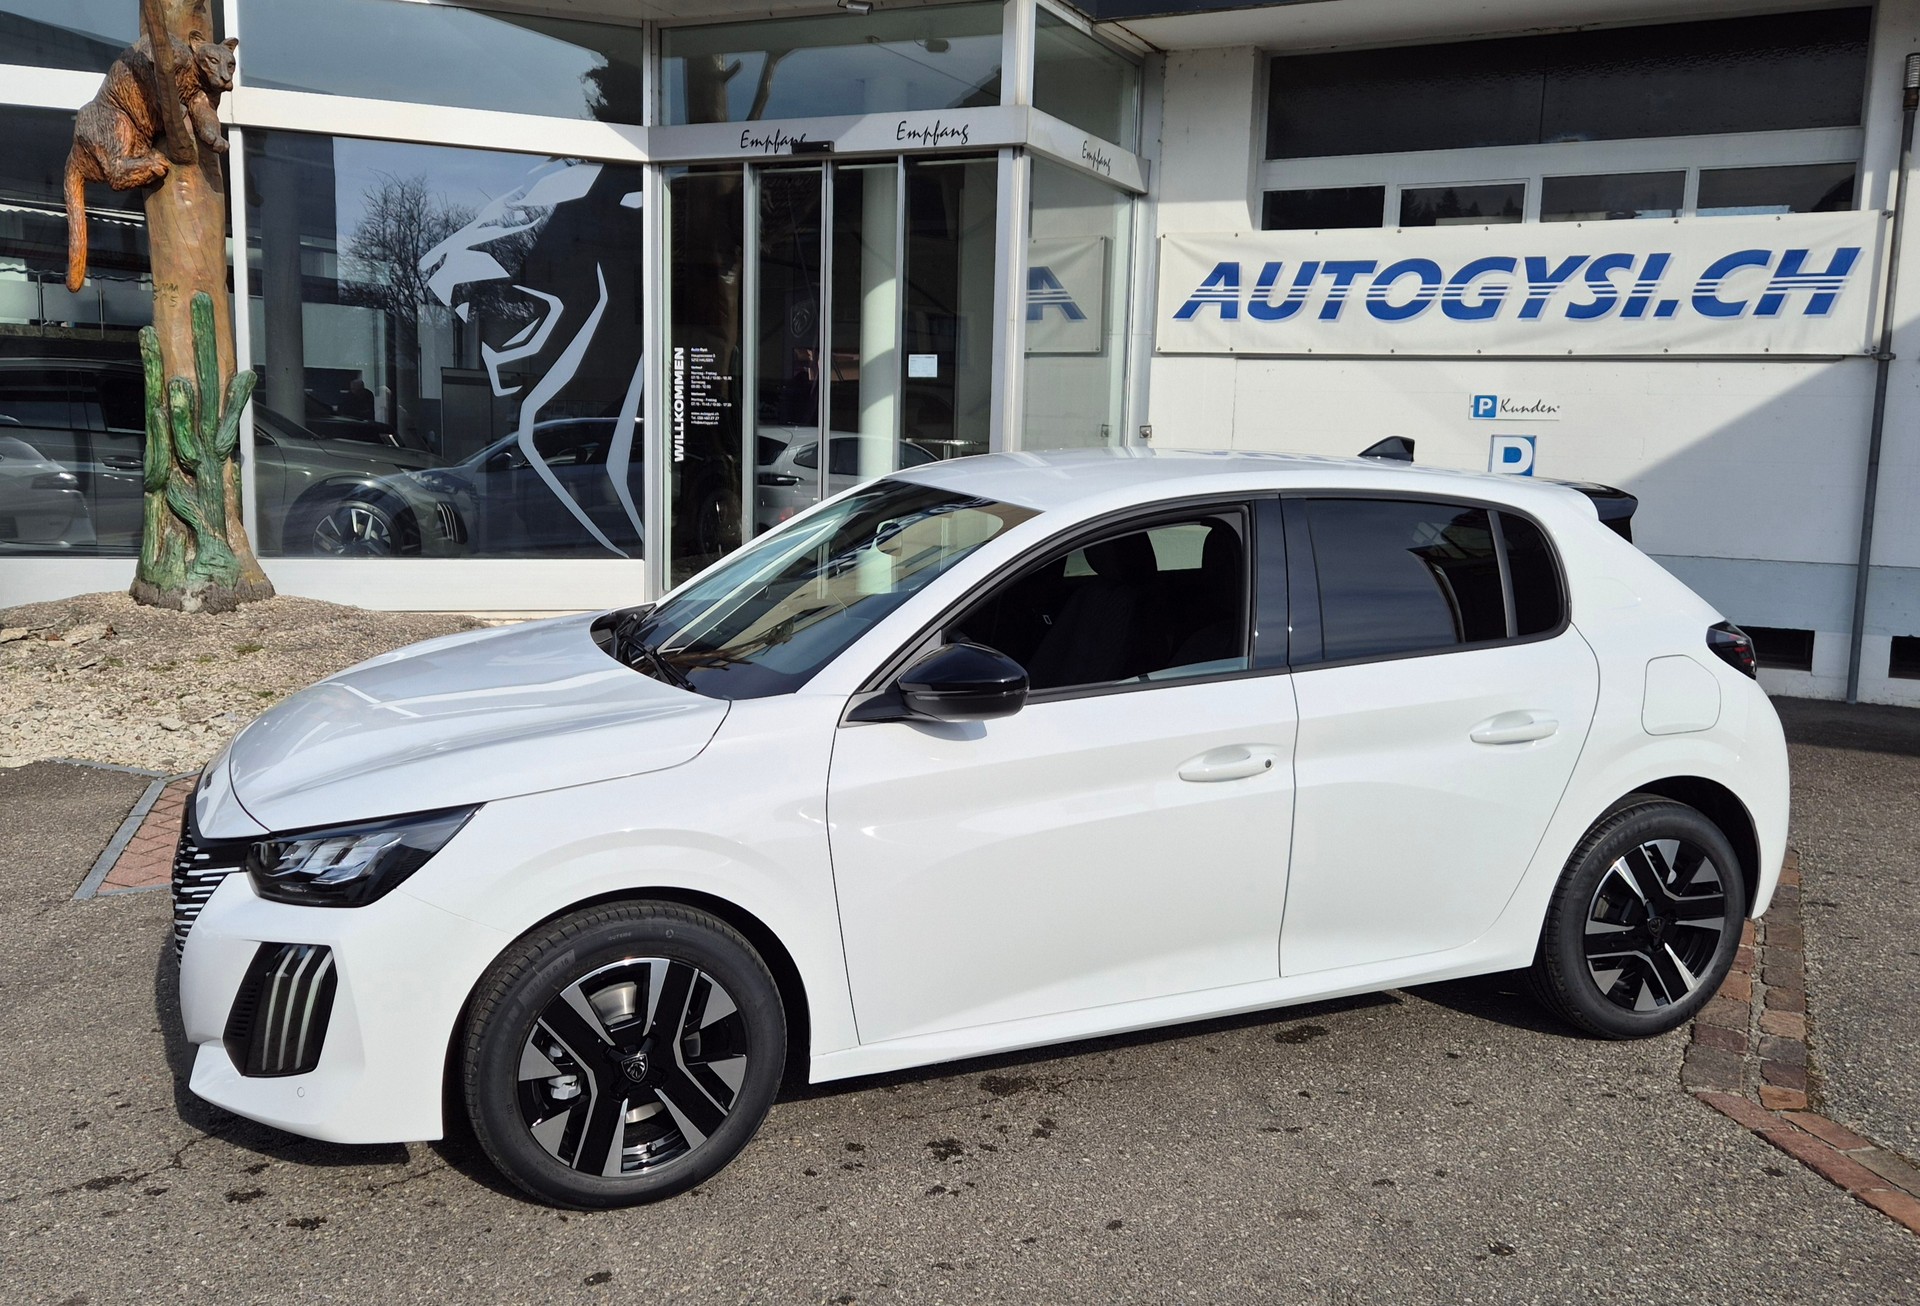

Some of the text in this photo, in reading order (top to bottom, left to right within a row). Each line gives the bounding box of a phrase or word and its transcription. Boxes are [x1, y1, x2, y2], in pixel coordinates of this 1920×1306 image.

[896, 120, 969, 146] Empfang
[1081, 140, 1111, 176] Empfang
[1172, 246, 1862, 323] AUTOGYSI.CH
[673, 347, 684, 462] WILLKOMMEN
[1478, 398, 1556, 415] P Kunden
